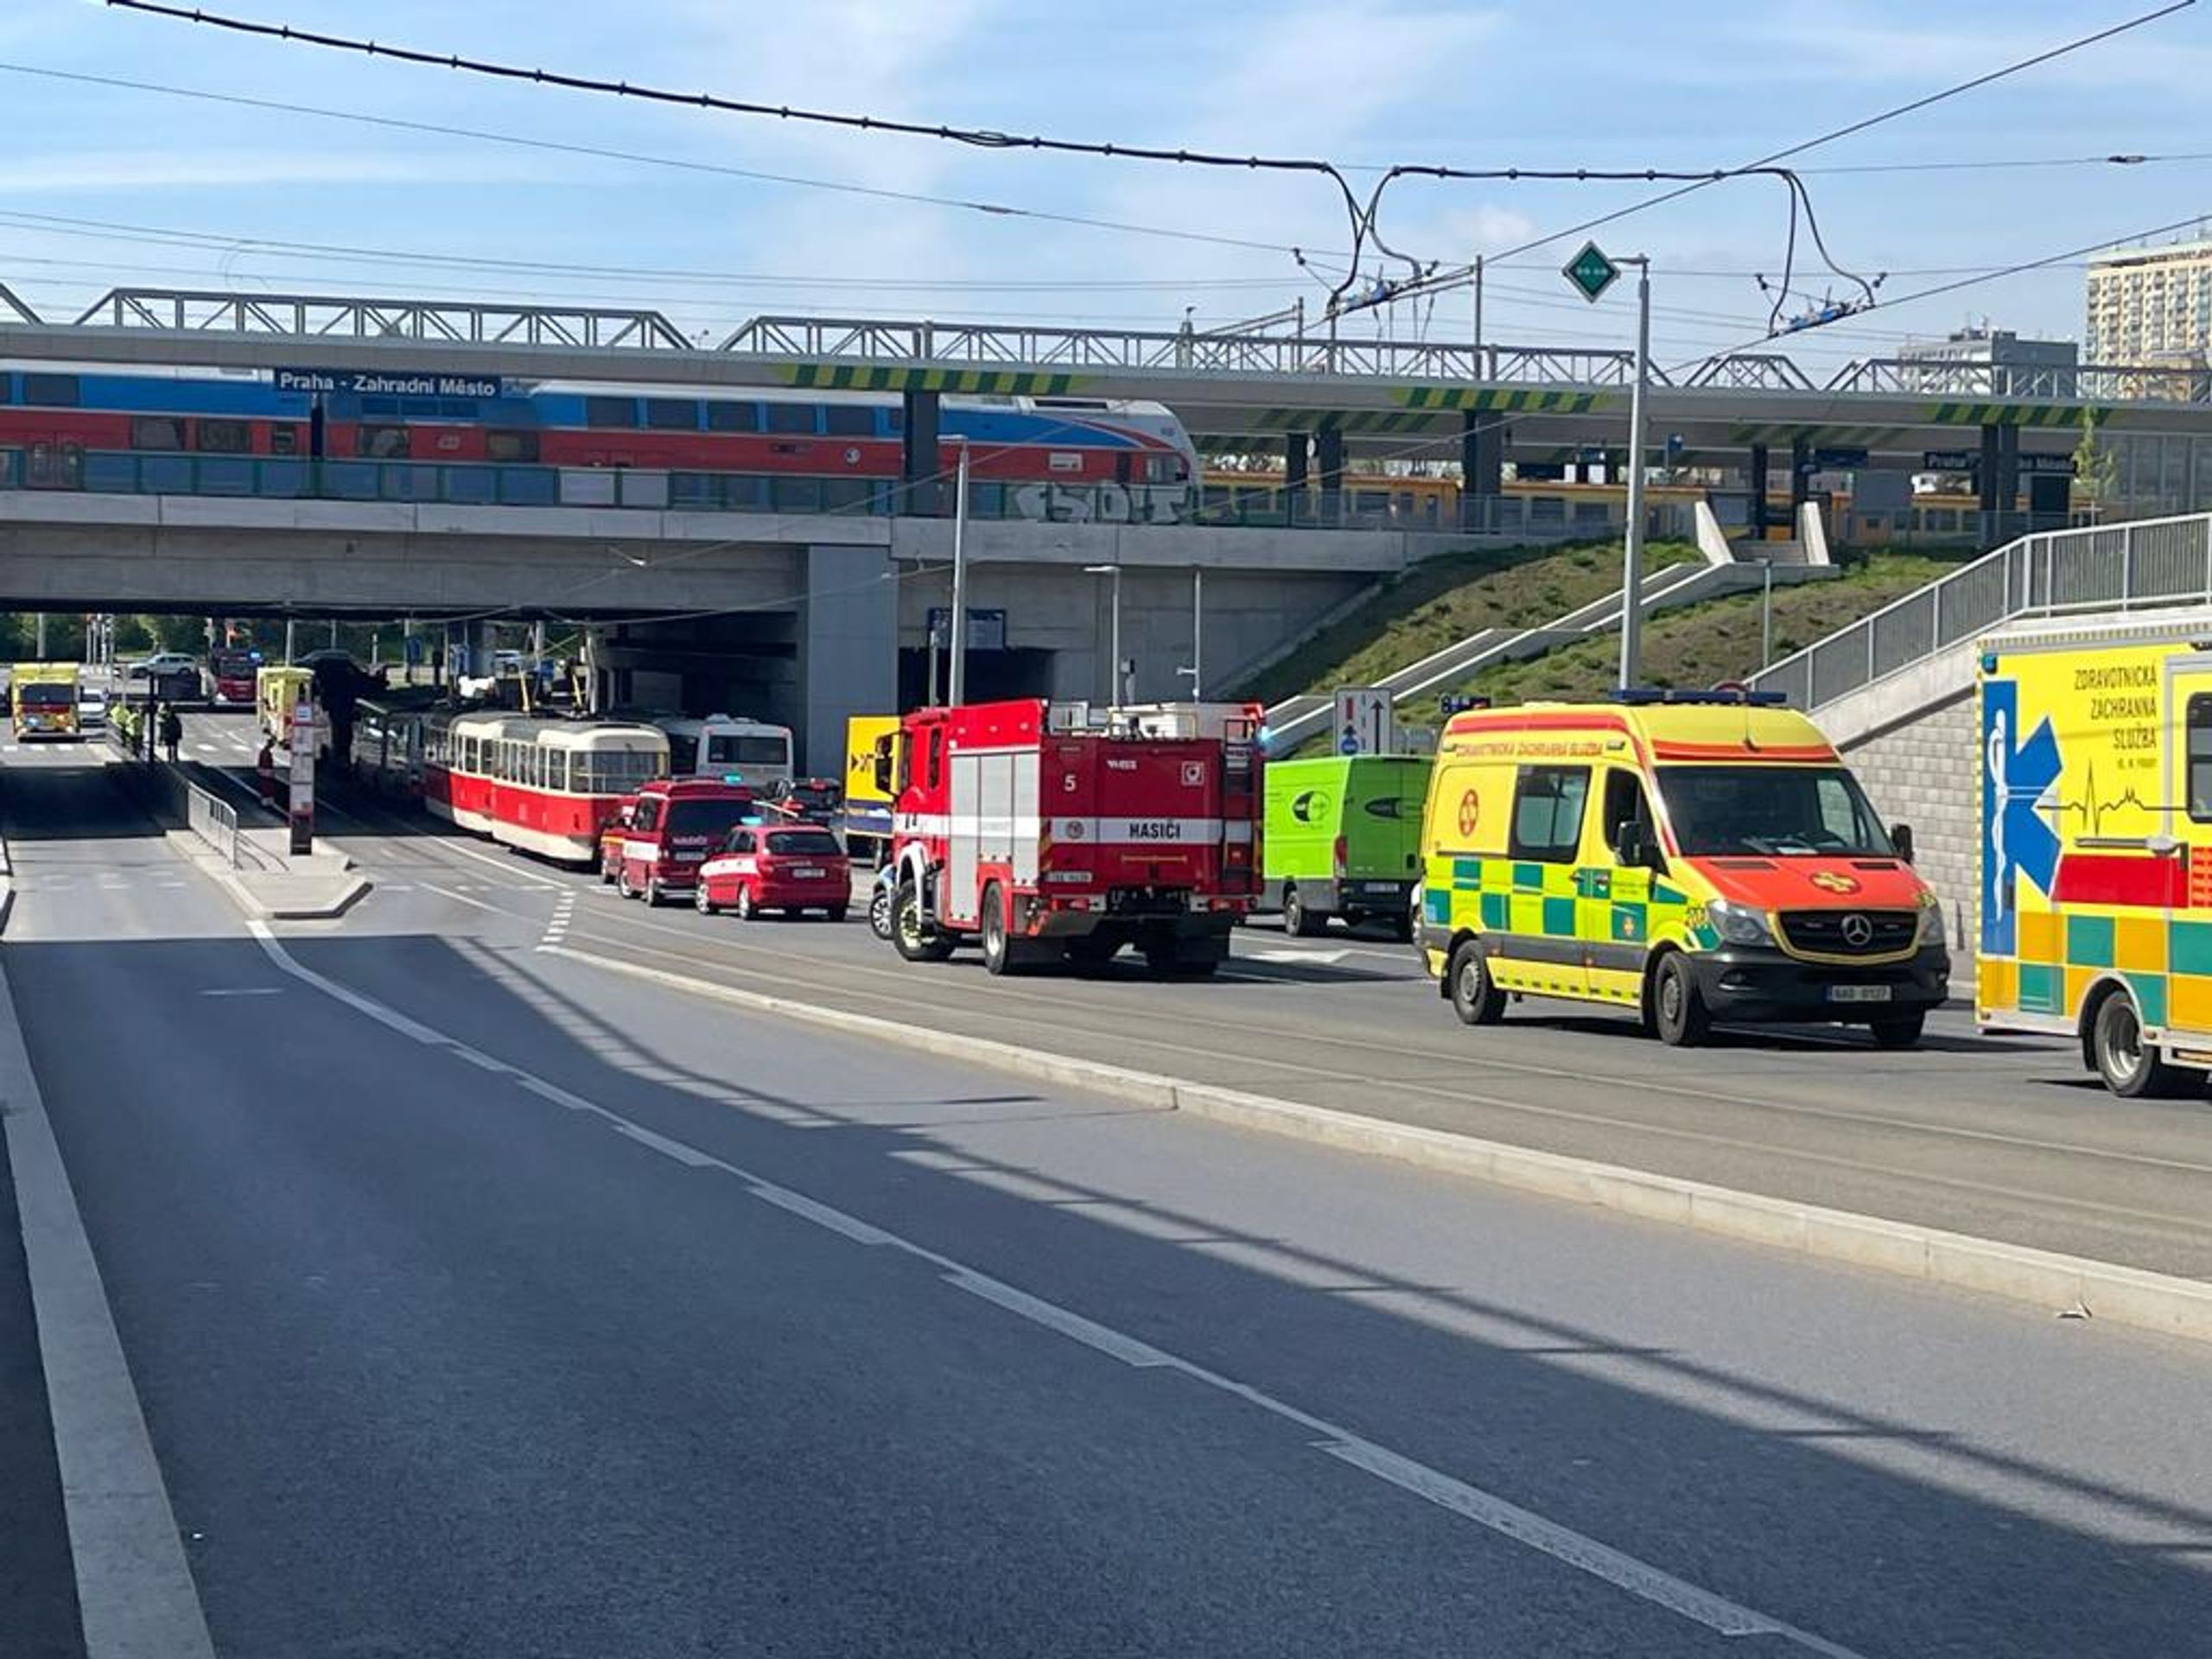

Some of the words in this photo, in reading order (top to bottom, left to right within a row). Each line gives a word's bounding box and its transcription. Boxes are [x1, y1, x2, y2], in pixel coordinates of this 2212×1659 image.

[280, 372, 334, 390] Praha
[353, 374, 435, 395] Zahradní
[439, 378, 496, 397] Město
[2113, 722, 2157, 749] SLUŽBA
[1064, 774, 1077, 791] 5
[1128, 818, 1181, 840] HASIČI
